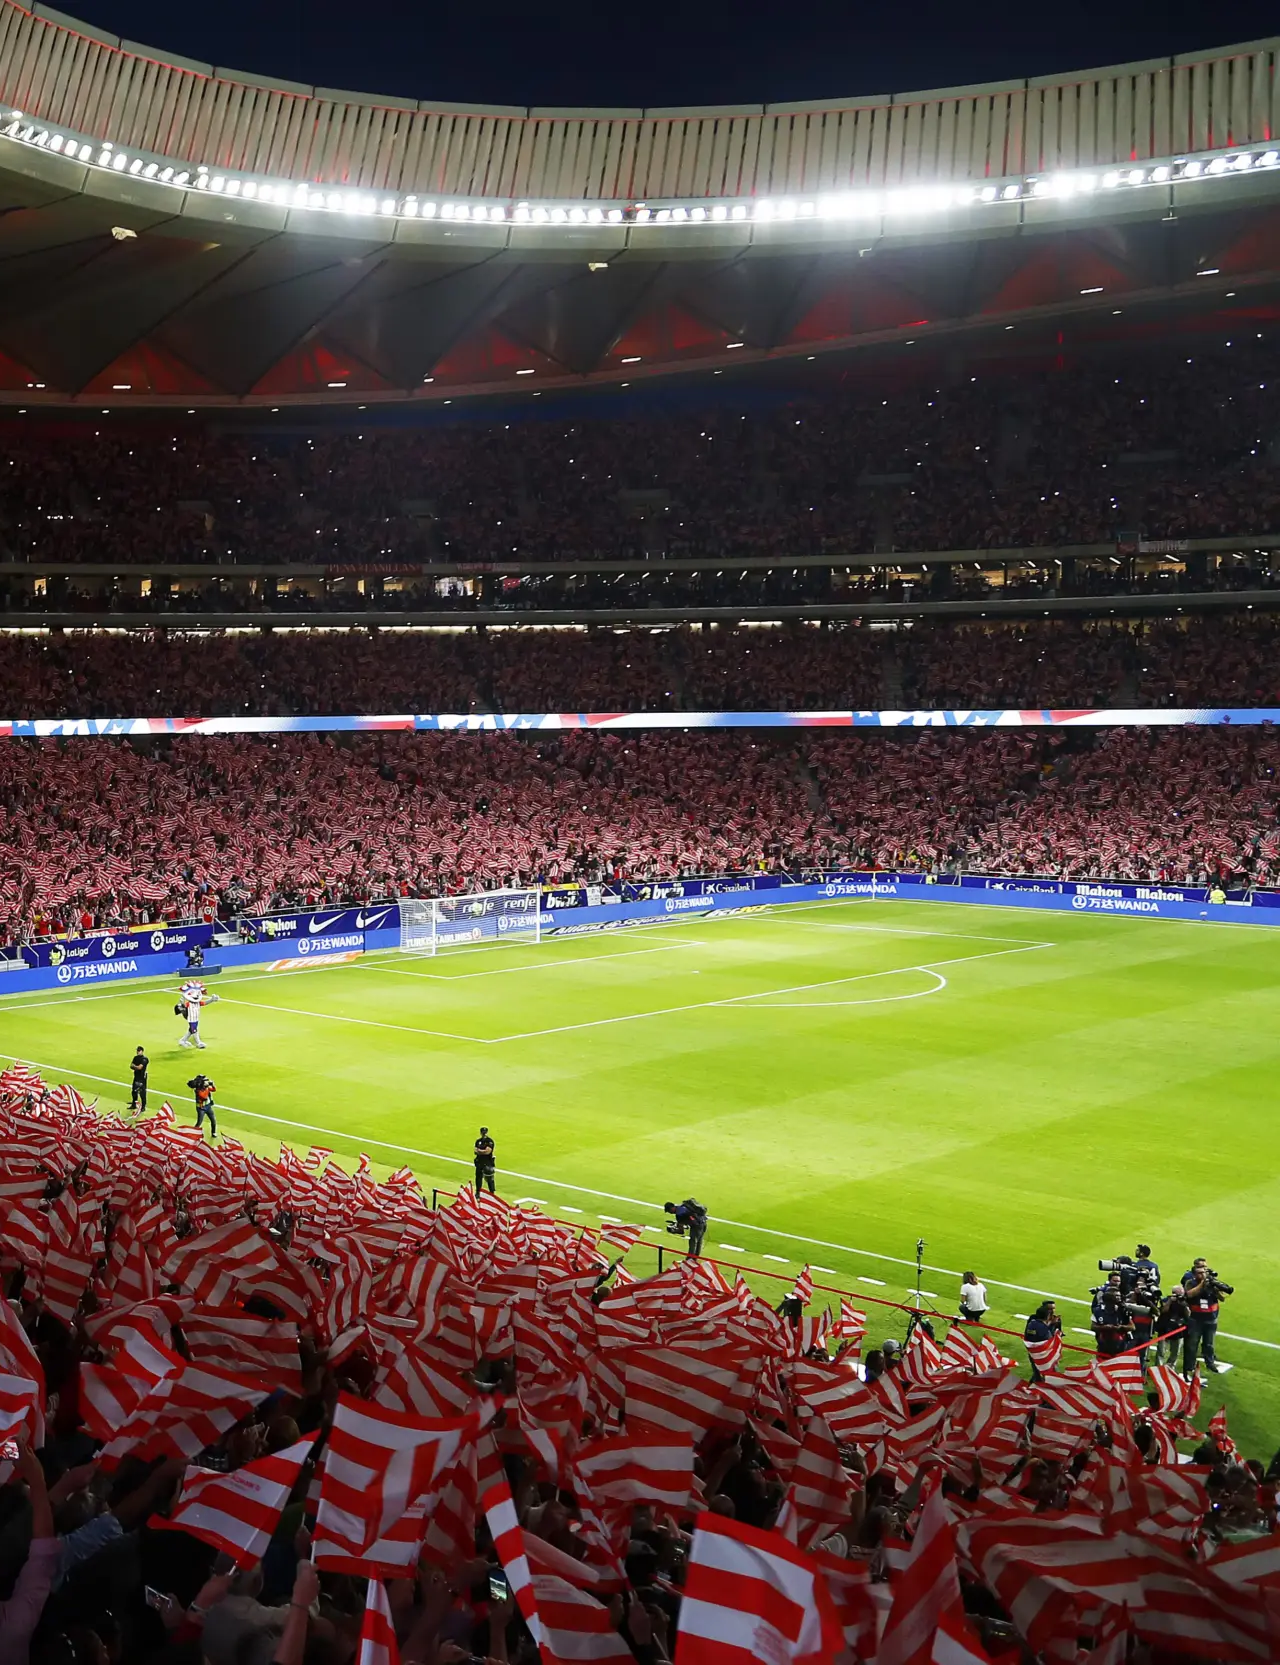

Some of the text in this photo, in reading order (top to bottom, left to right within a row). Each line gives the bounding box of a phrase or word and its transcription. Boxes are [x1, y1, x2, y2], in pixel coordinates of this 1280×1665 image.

[1076, 884, 1123, 898] Mahou
[1136, 888, 1184, 902] Mahou
[462, 898, 494, 916] refe
[504, 894, 536, 912] renfe
[1114, 899, 1160, 913] WANDA
[261, 918, 297, 933] Mhou
[117, 940, 139, 951] LaLiga
[165, 934, 187, 945] LaLiga
[331, 935, 364, 948] WANDA
[67, 947, 89, 958] LaLiga
[97, 960, 138, 975] WANDA
